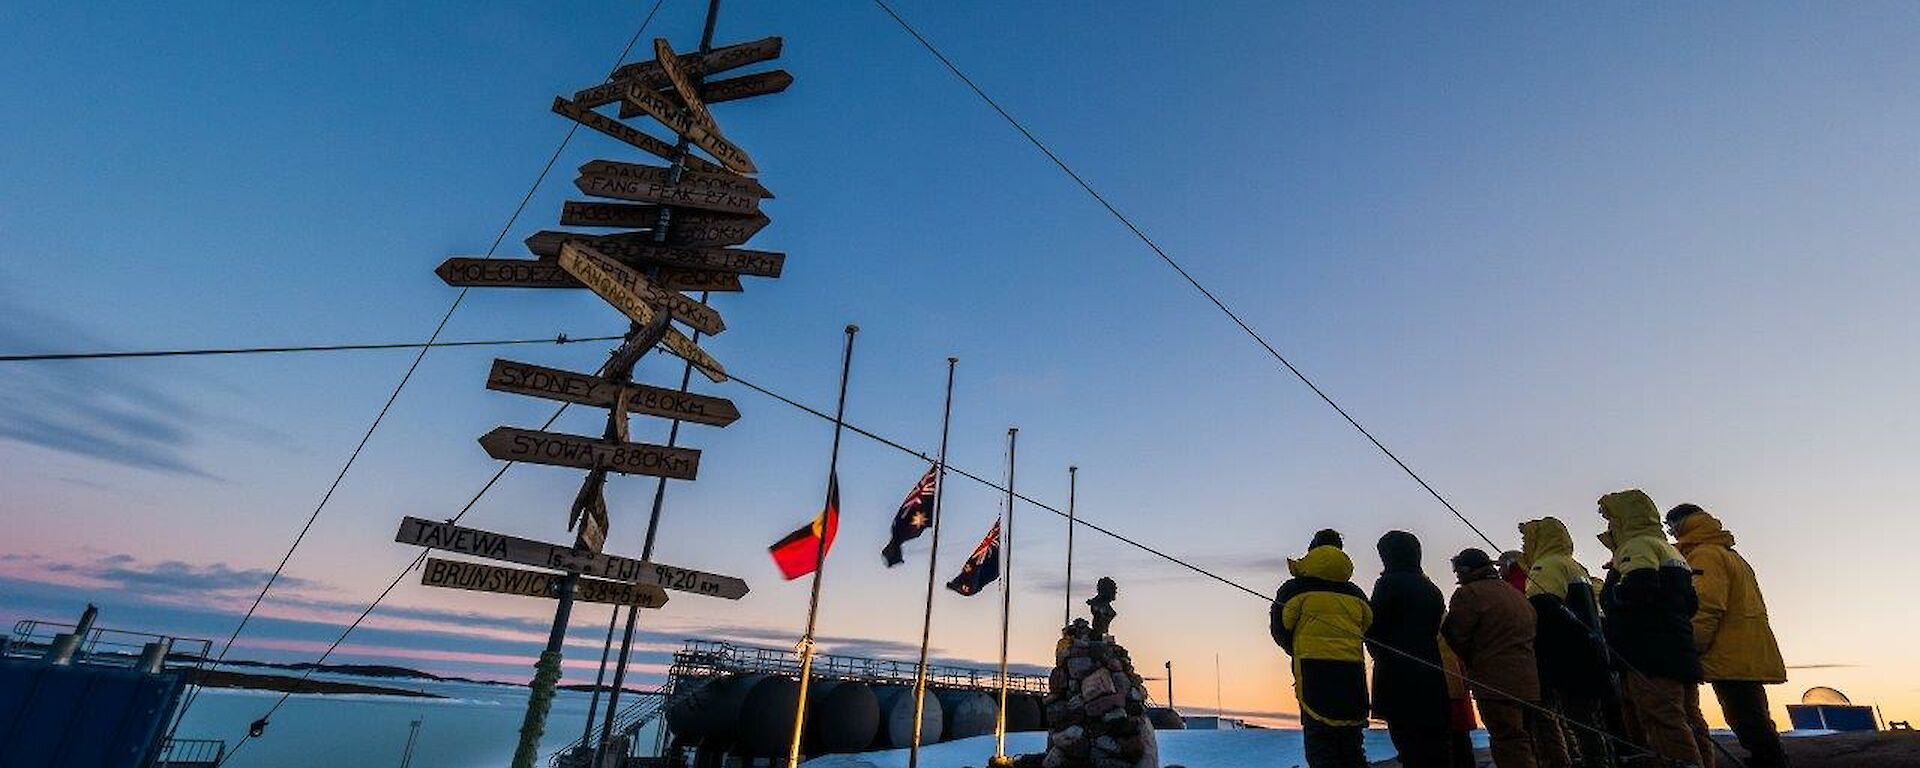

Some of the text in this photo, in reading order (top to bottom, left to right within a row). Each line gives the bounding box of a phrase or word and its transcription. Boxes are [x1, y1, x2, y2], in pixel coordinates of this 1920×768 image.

[629, 83, 692, 132] DARWIN
[591, 177, 638, 193] FANG
[648, 183, 693, 203] PEAK
[606, 166, 667, 182] DAVIS
[450, 260, 572, 283] MOLODEZ
[499, 366, 600, 398] SYDNEY
[511, 434, 690, 473] SYOWA 880KM
[414, 521, 508, 558] TAVEWA
[604, 557, 640, 580] FIJI
[655, 564, 697, 589] 9420
[430, 561, 555, 595] BRUNSWICK
